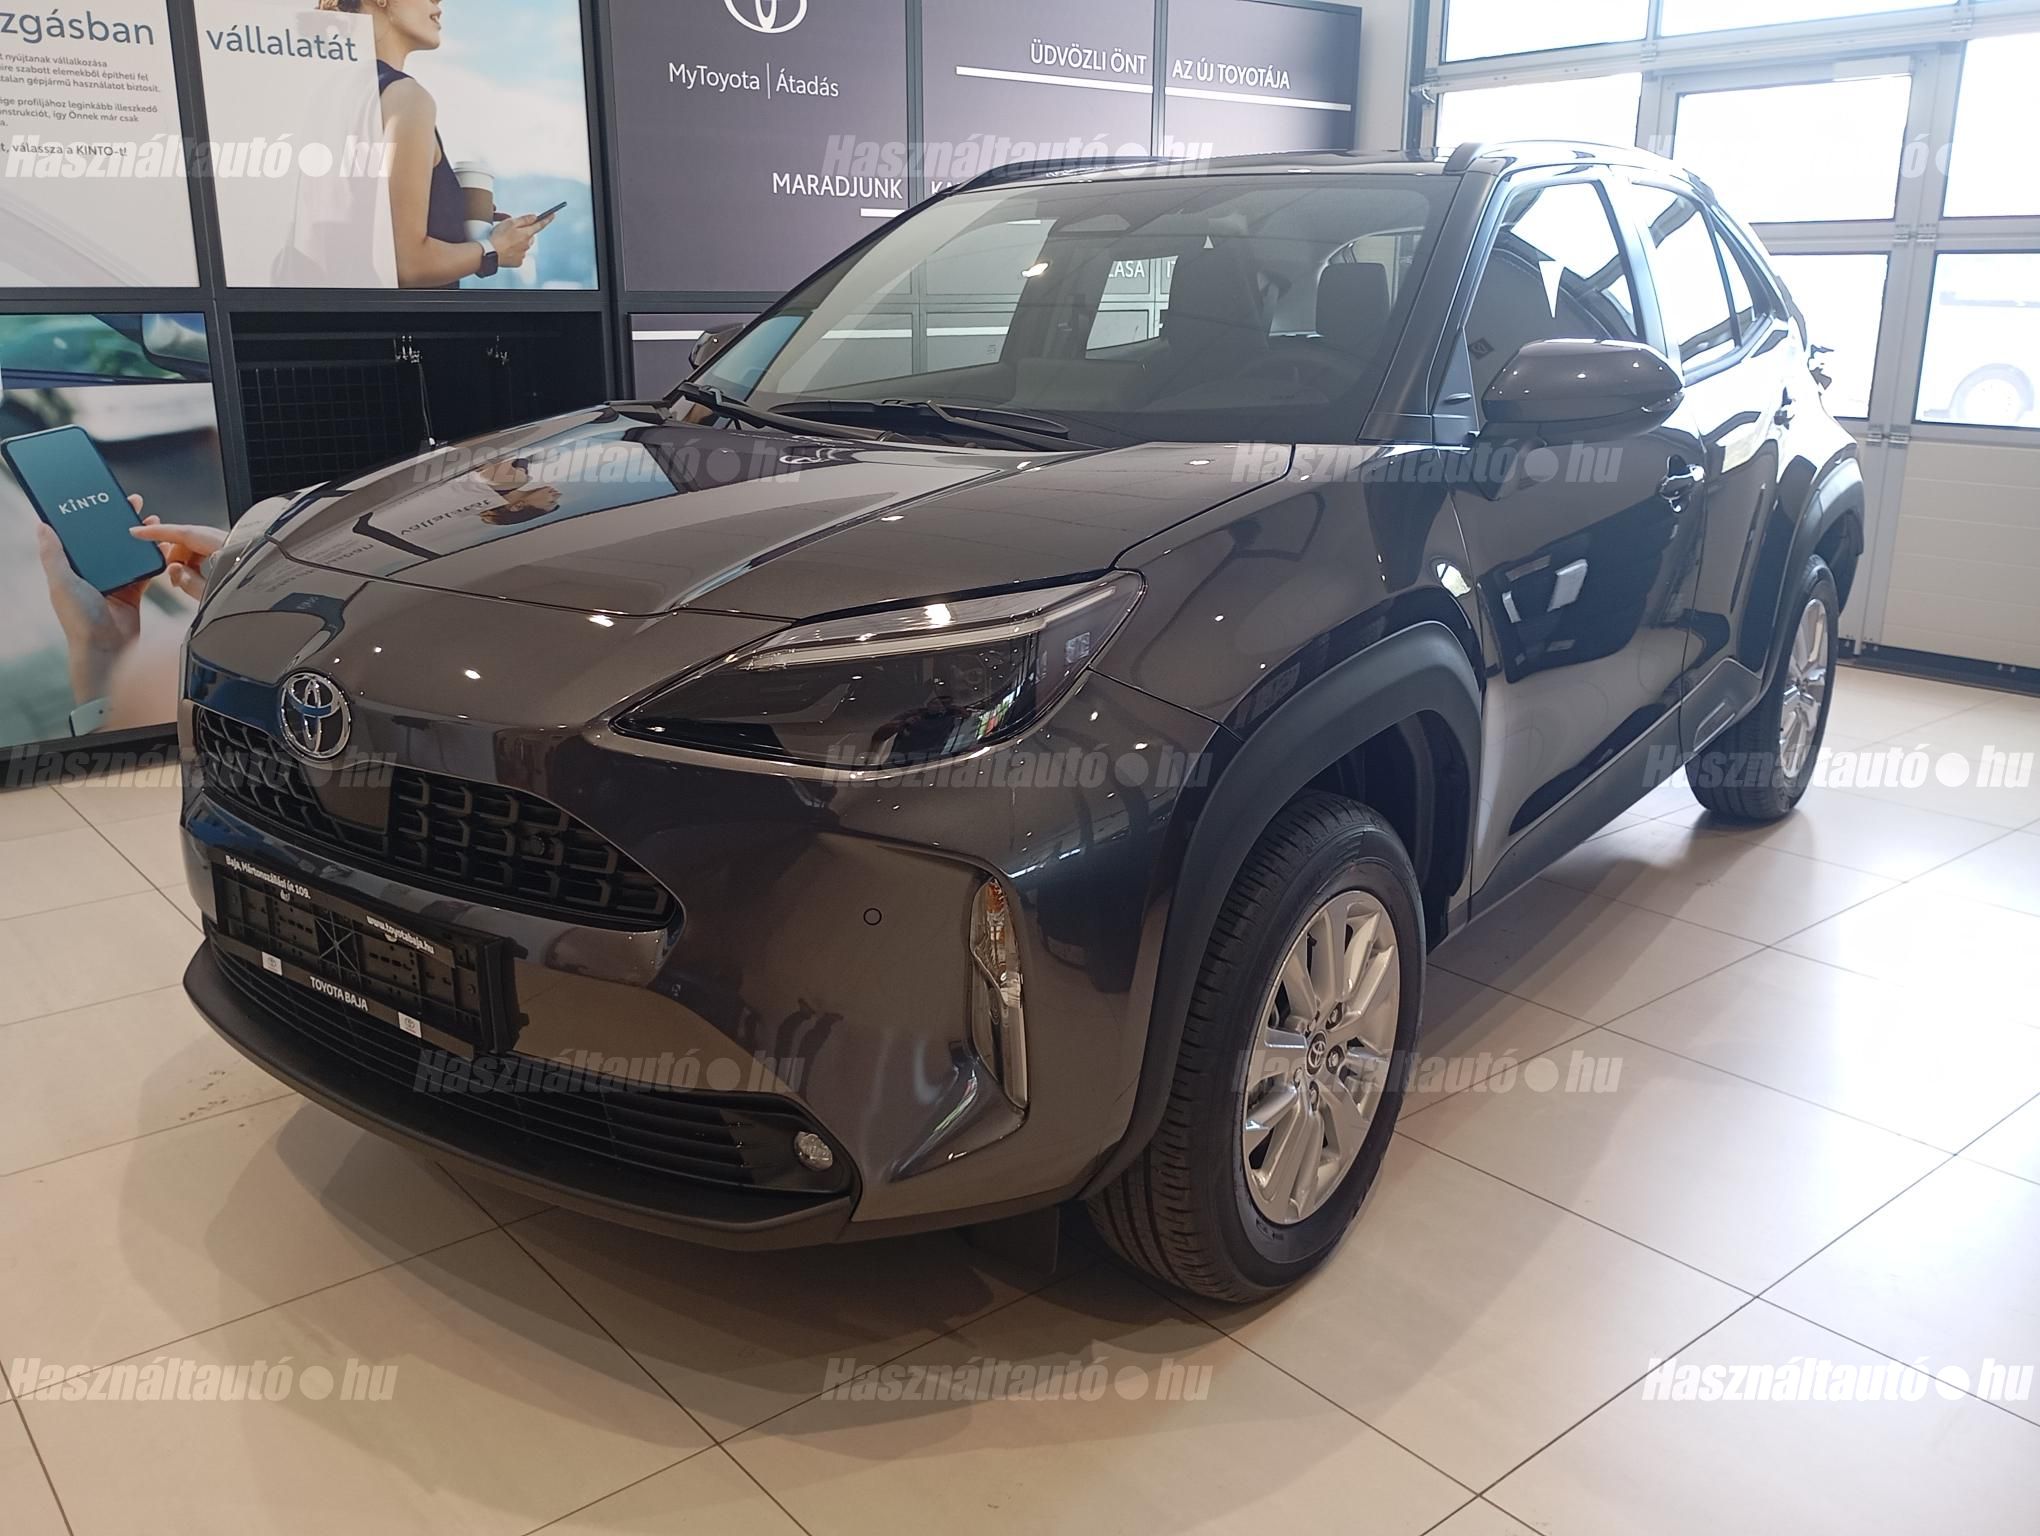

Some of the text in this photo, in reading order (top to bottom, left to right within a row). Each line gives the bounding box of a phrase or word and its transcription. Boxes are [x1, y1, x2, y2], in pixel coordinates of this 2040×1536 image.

[206, 25, 358, 62] vállalatát
[15, 65, 50, 74] szabott
[137, 71, 149, 81] fel
[1030, 38, 1291, 89] ÜDVÖZLI ÖNT AZ ÚJ TOYOTÁJA
[73, 79, 125, 91] használatot
[668, 62, 839, 97] MyToyota Átadás
[68, 100, 113, 111] leginkább
[100, 112, 118, 121] már
[119, 113, 139, 122] csak
[12, 142, 63, 154] válassza
[772, 172, 903, 199] MARADJUNK
[309, 975, 369, 1012] TOYOTA BAJA
